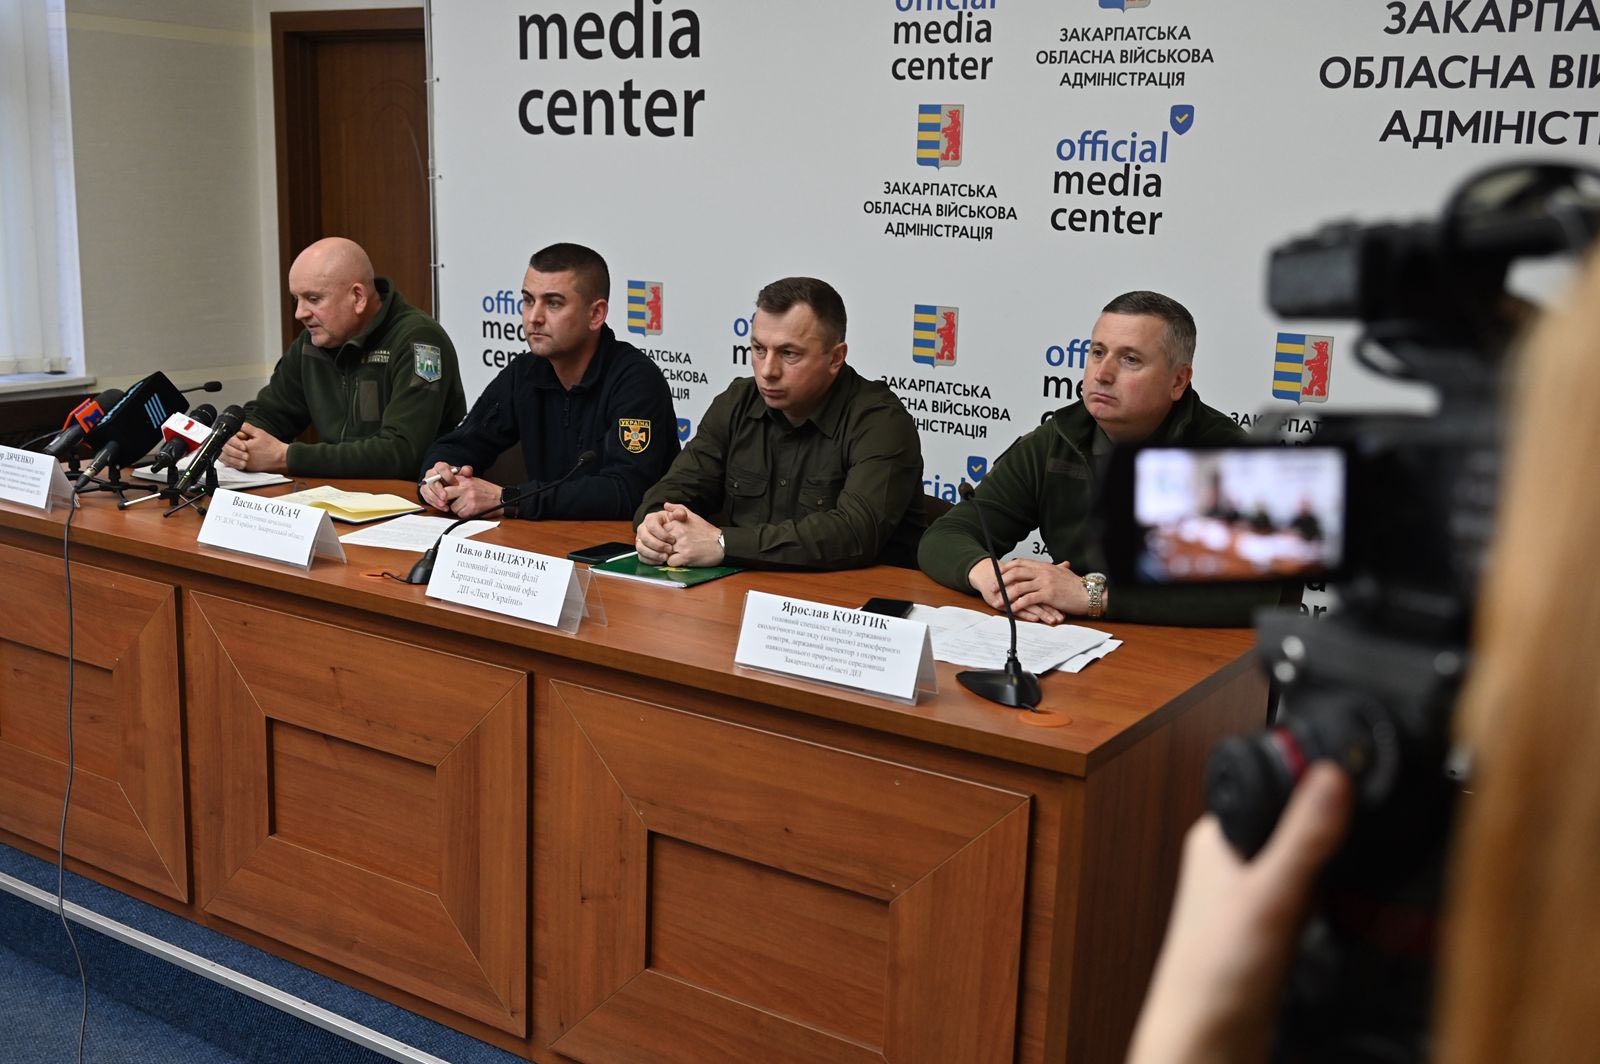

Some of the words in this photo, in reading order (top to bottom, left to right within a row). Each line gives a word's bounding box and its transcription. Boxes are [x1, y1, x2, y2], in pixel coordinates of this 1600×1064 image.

[519, 0, 700, 60] media
[894, 11, 991, 44] media
[1060, 26, 1191, 42] ЗАКАРПАТСЬКА
[892, 53, 993, 80] center
[1036, 50, 1115, 64] ОБЛАСНА
[1120, 47, 1214, 63] ВІЙСЬКОВА
[1060, 72, 1185, 89] АДМІНІСТРАЦІЯ
[1320, 55, 1535, 89] ОБЛАСНА
[519, 79, 705, 137] center
[1379, 110, 1600, 149] АДМІНІСТ
[1056, 130, 1168, 163] official
[884, 182, 997, 198] ЗАКАРПАТСЬКА
[1053, 163, 1162, 197] media
[864, 201, 932, 216] ОБЛАСНА
[936, 202, 1017, 220] ВІЙСЬКОВА
[1051, 206, 1162, 235] center
[885, 222, 992, 241] АДМІНІСТРАЦІЯ
[931, 399, 1011, 421] ВІЙСЬКОВА
[232, 496, 262, 511] Василь
[264, 503, 301, 519] СОКАЧ
[456, 543, 482, 557] Павло
[484, 549, 549, 571] ВАНДЖУРАК
[782, 601, 829, 619] Ярослав
[832, 610, 890, 630] КОВТИК
